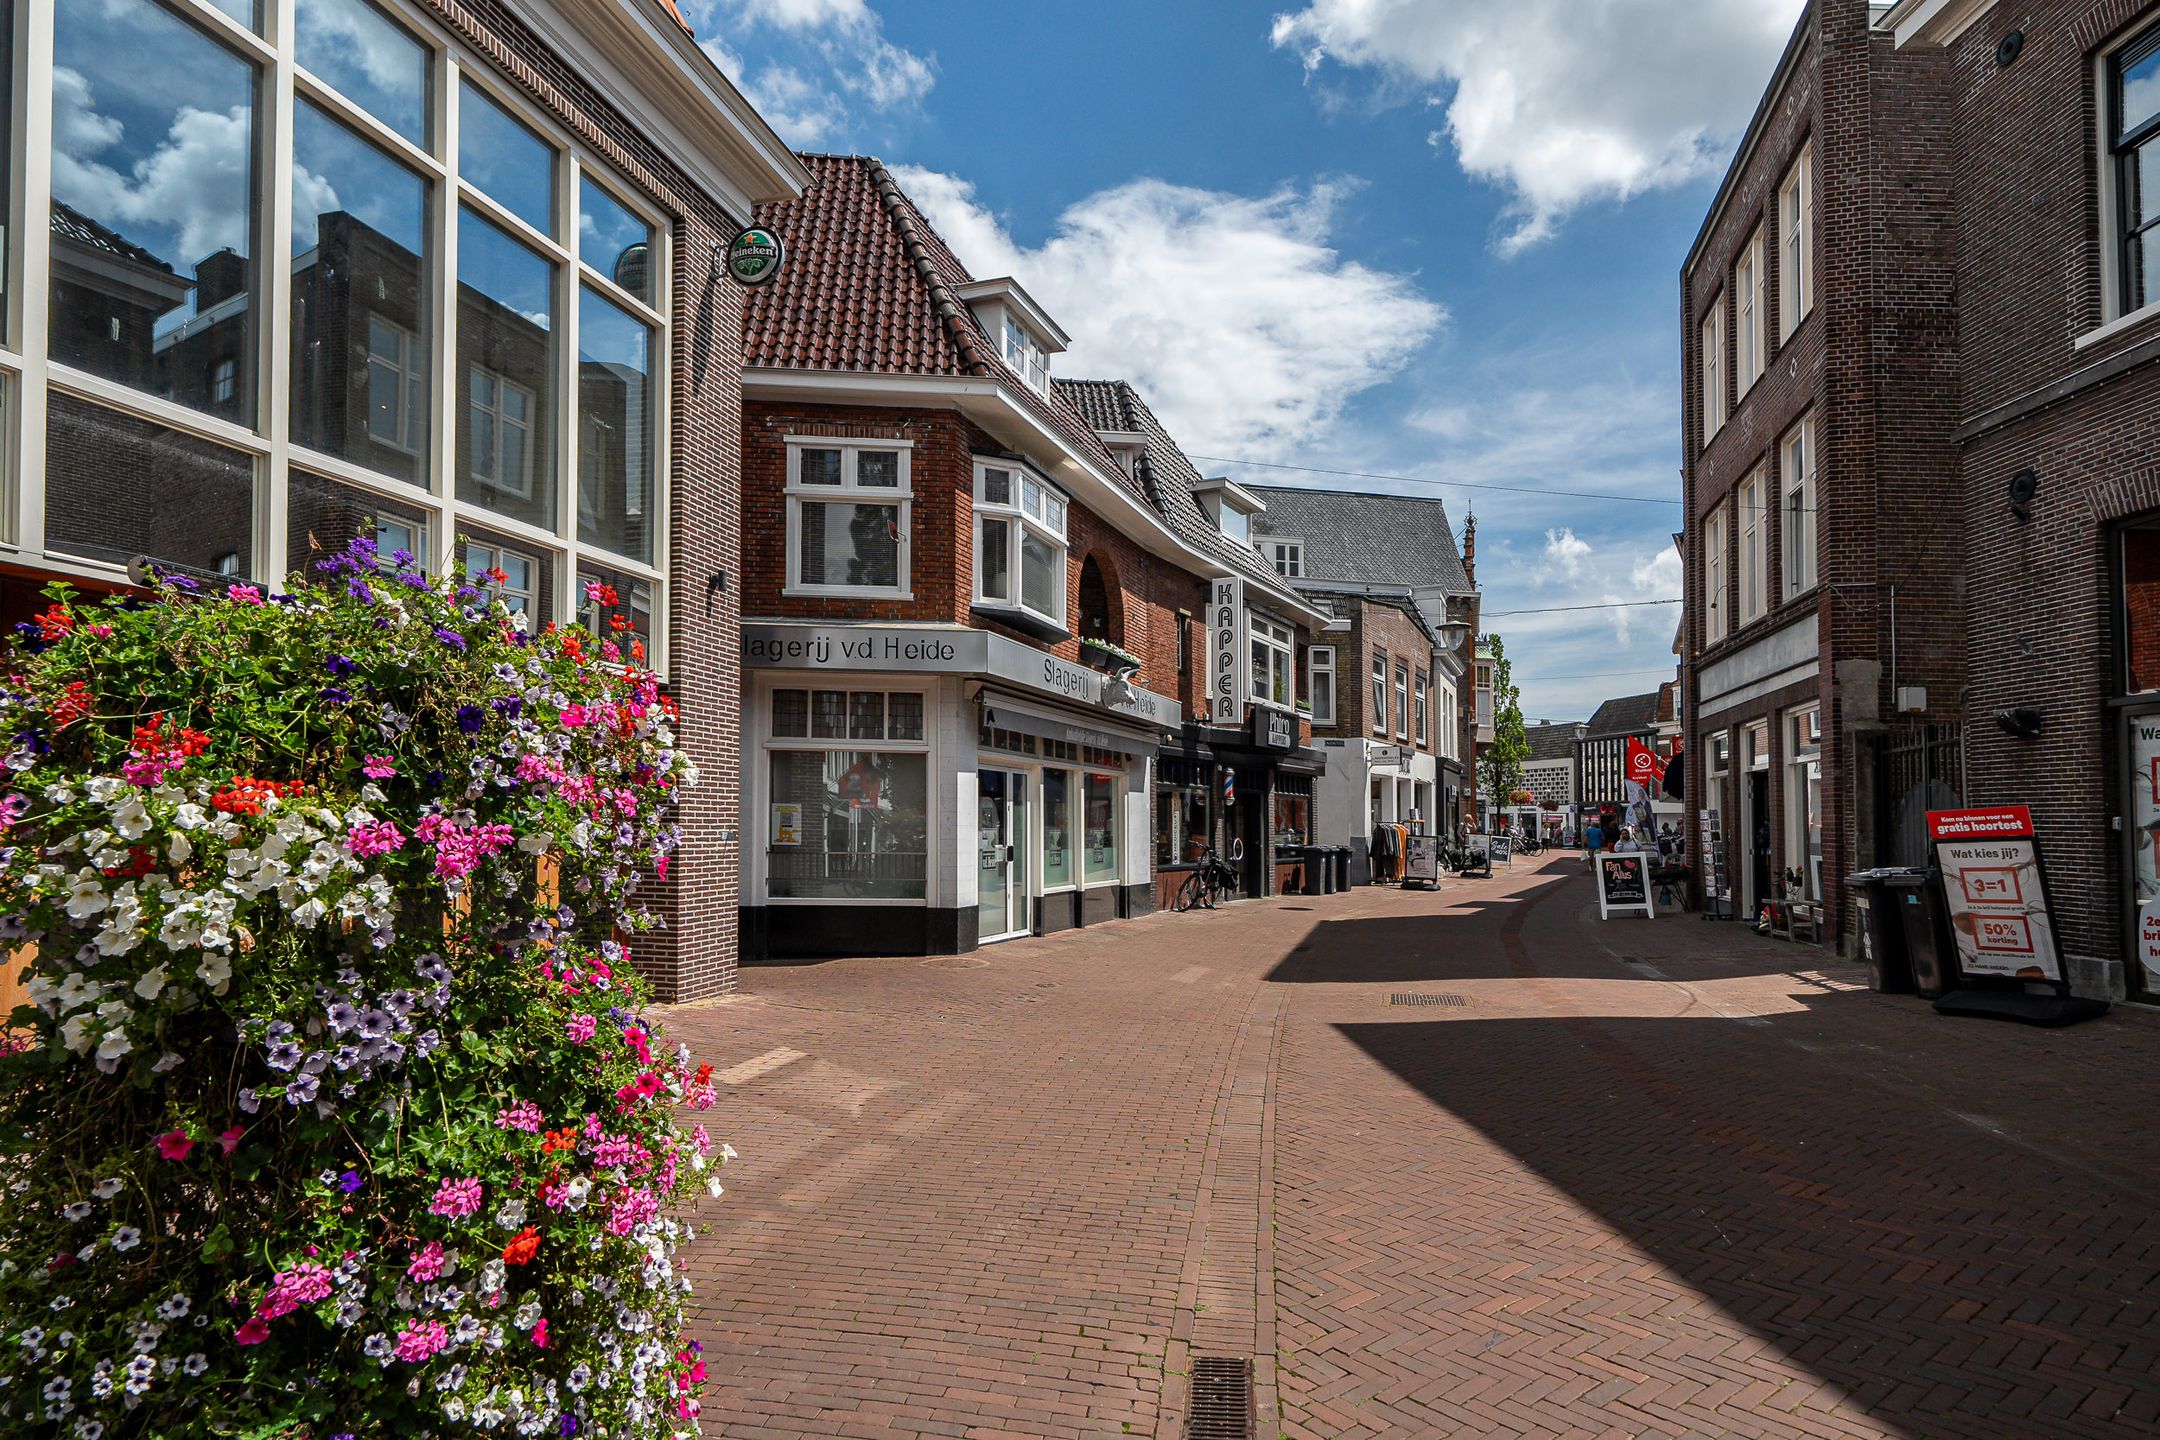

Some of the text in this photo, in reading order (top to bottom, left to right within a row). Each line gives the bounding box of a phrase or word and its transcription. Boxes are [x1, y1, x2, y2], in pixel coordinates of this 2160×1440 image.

[731, 245, 774, 260] Heineken
[741, 634, 830, 663] lagerij
[884, 637, 955, 661] Heide
[1218, 583, 1233, 717] KAPPER
[1044, 658, 1089, 700] Slagerij
[1937, 820, 2023, 835] gratis hoortest
[1491, 840, 1508, 851] Sale
[1951, 848, 2019, 860] Wat kies jij?
[1605, 861, 1621, 872] Fan
[1974, 879, 2007, 893] 3=1
[2146, 915, 2160, 927] 2e
[1984, 923, 2017, 936] 50%
[1987, 936, 2018, 946] korting
